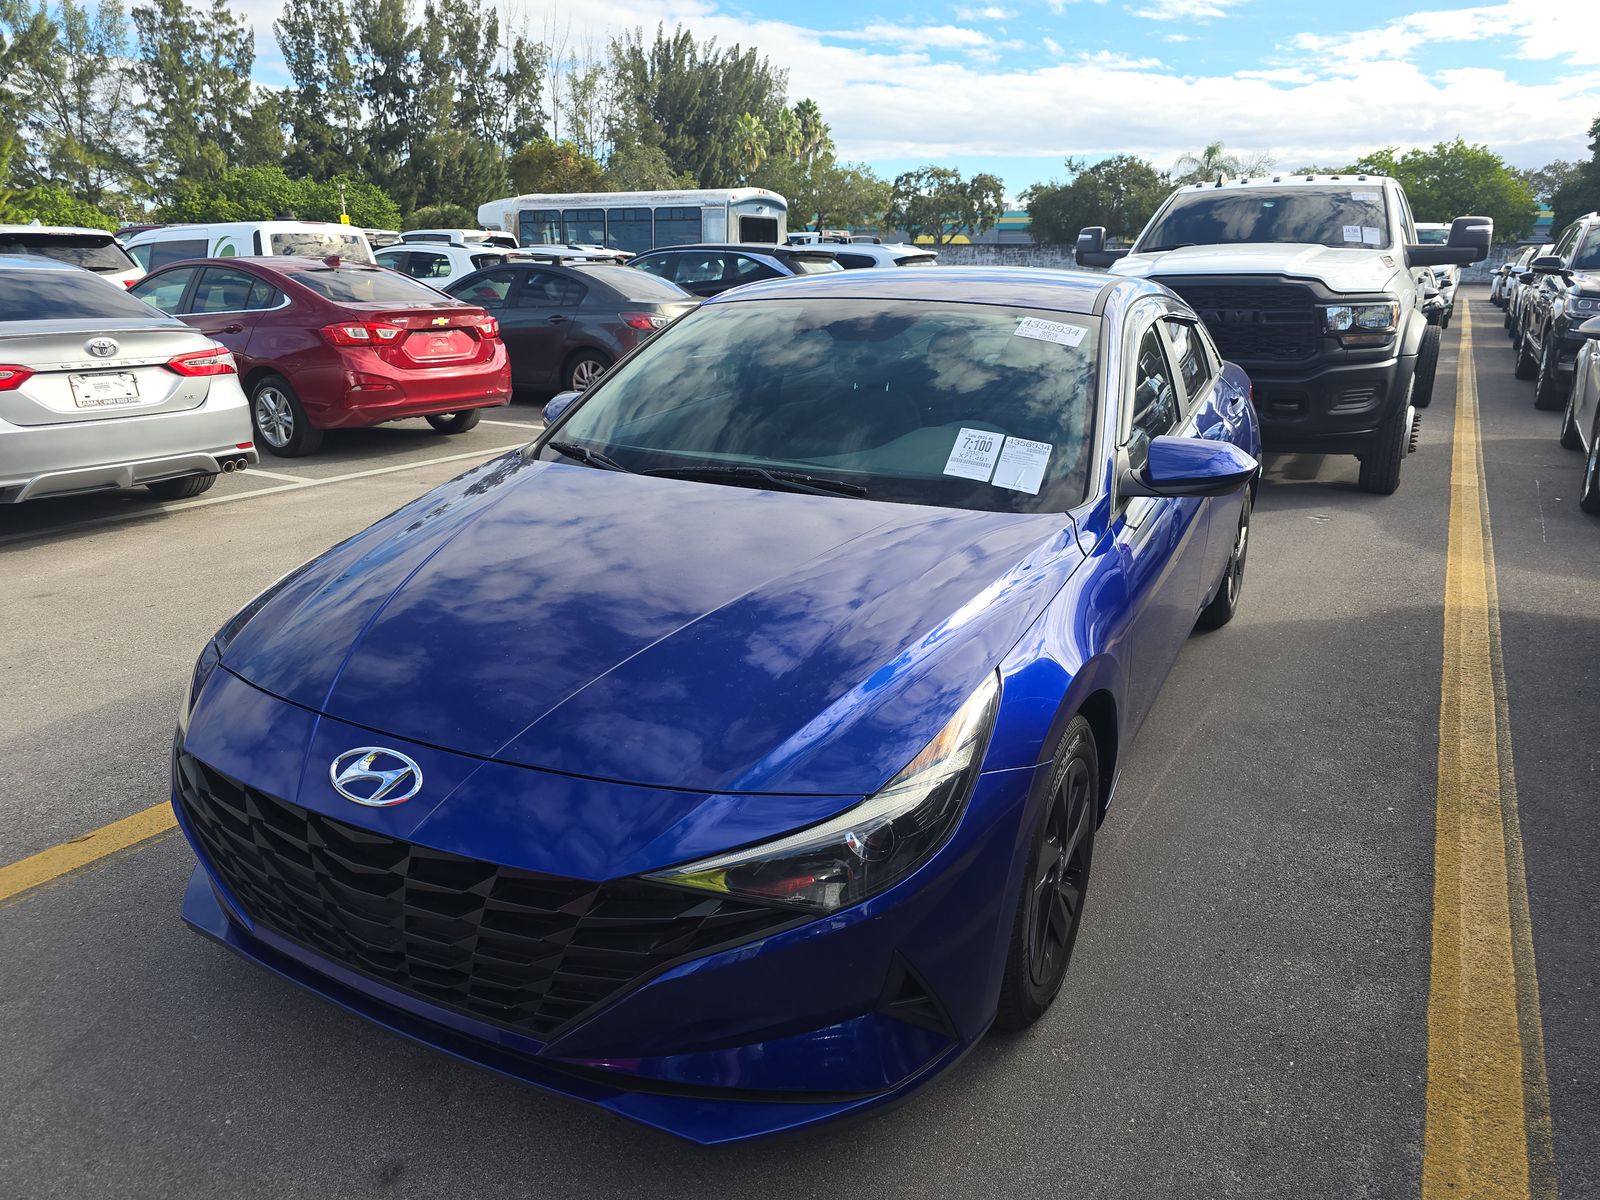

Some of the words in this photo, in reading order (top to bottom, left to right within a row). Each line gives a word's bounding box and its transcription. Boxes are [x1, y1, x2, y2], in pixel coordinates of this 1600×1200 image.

[1023, 319, 1080, 337] 4356934
[962, 437, 993, 453] 7:100
[1007, 438, 1051, 451] 4356934
